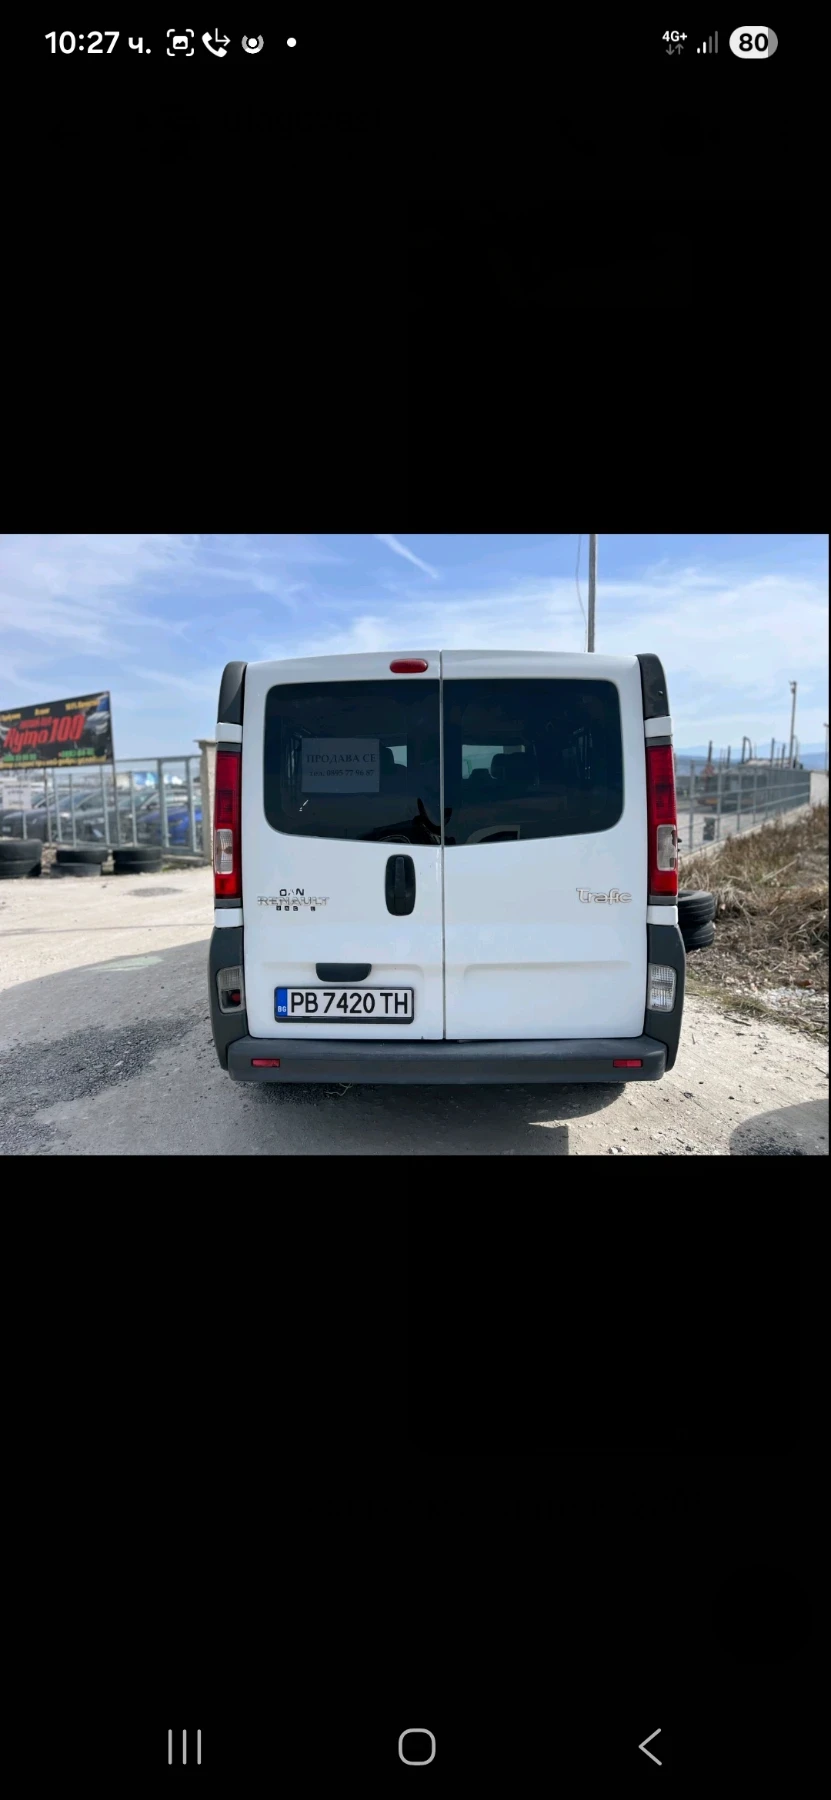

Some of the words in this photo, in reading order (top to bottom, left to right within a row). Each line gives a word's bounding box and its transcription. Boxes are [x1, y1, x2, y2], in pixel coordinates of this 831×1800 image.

[306, 753, 360, 765] ПРОДАВА
[362, 753, 377, 763] СЕ
[257, 896, 330, 906] RENAULT
[575, 887, 633, 906] Trafic
[277, 1005, 287, 1013] BG
[290, 991, 319, 1014] PB
[322, 991, 376, 1014] 7420
[379, 992, 408, 1015] TH
